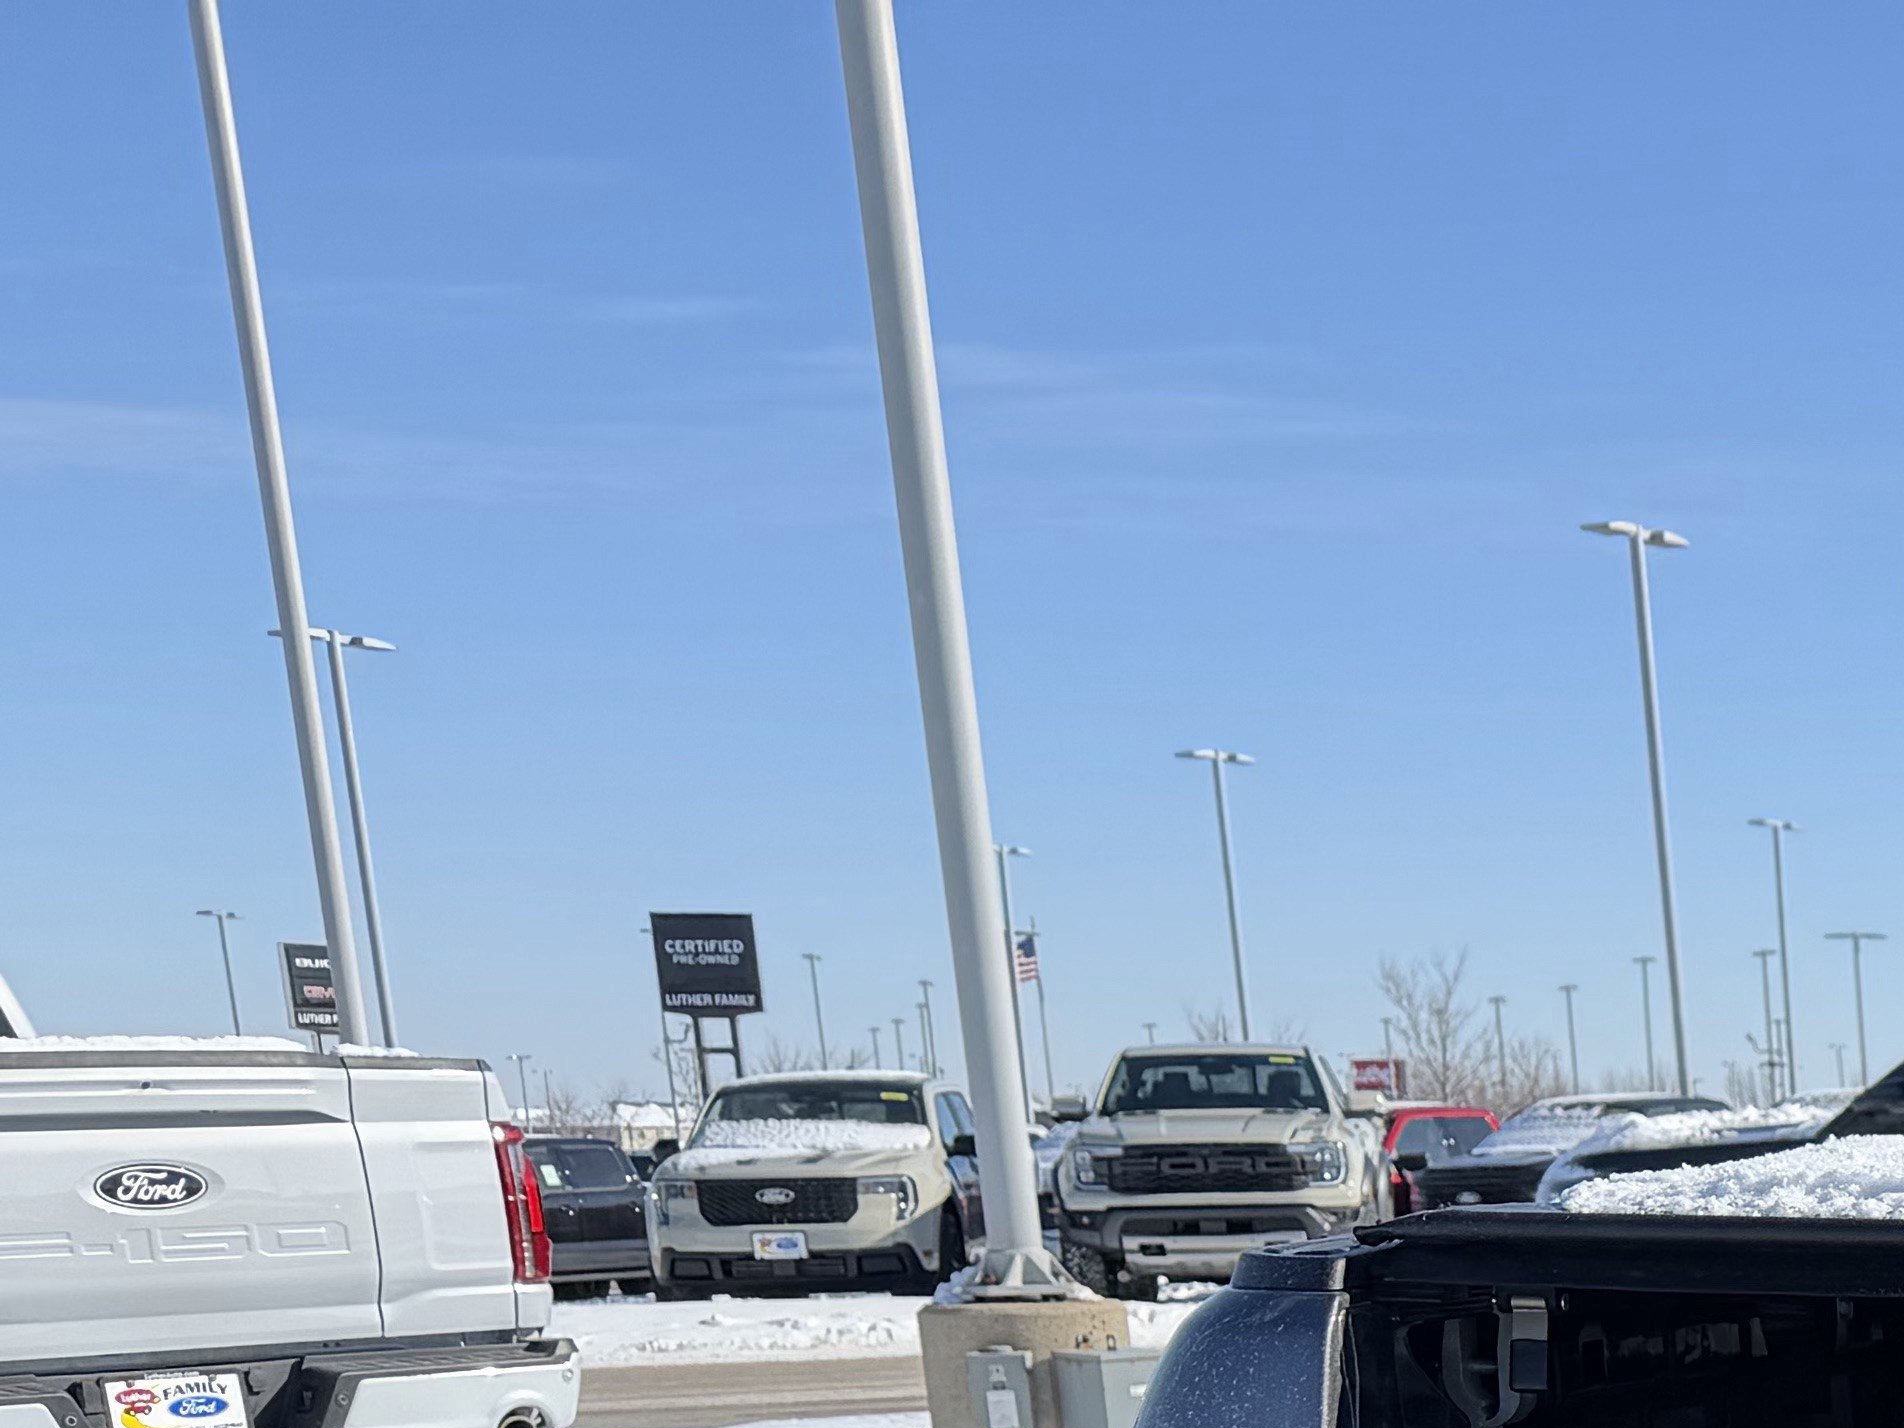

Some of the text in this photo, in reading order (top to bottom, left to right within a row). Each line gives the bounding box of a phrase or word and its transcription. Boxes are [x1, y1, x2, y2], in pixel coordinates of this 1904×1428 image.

[664, 939, 744, 954] CERTIFIED
[295, 957, 331, 969] BUIC
[672, 953, 740, 965] PRE-OWNED
[303, 985, 337, 999] GM
[665, 993, 757, 1007] LUTHER FAMILY
[297, 1012, 332, 1025] LUTHER
[117, 1171, 187, 1202] Ford
[163, 1381, 228, 1400] FAMILY
[179, 1399, 216, 1416] Ford
